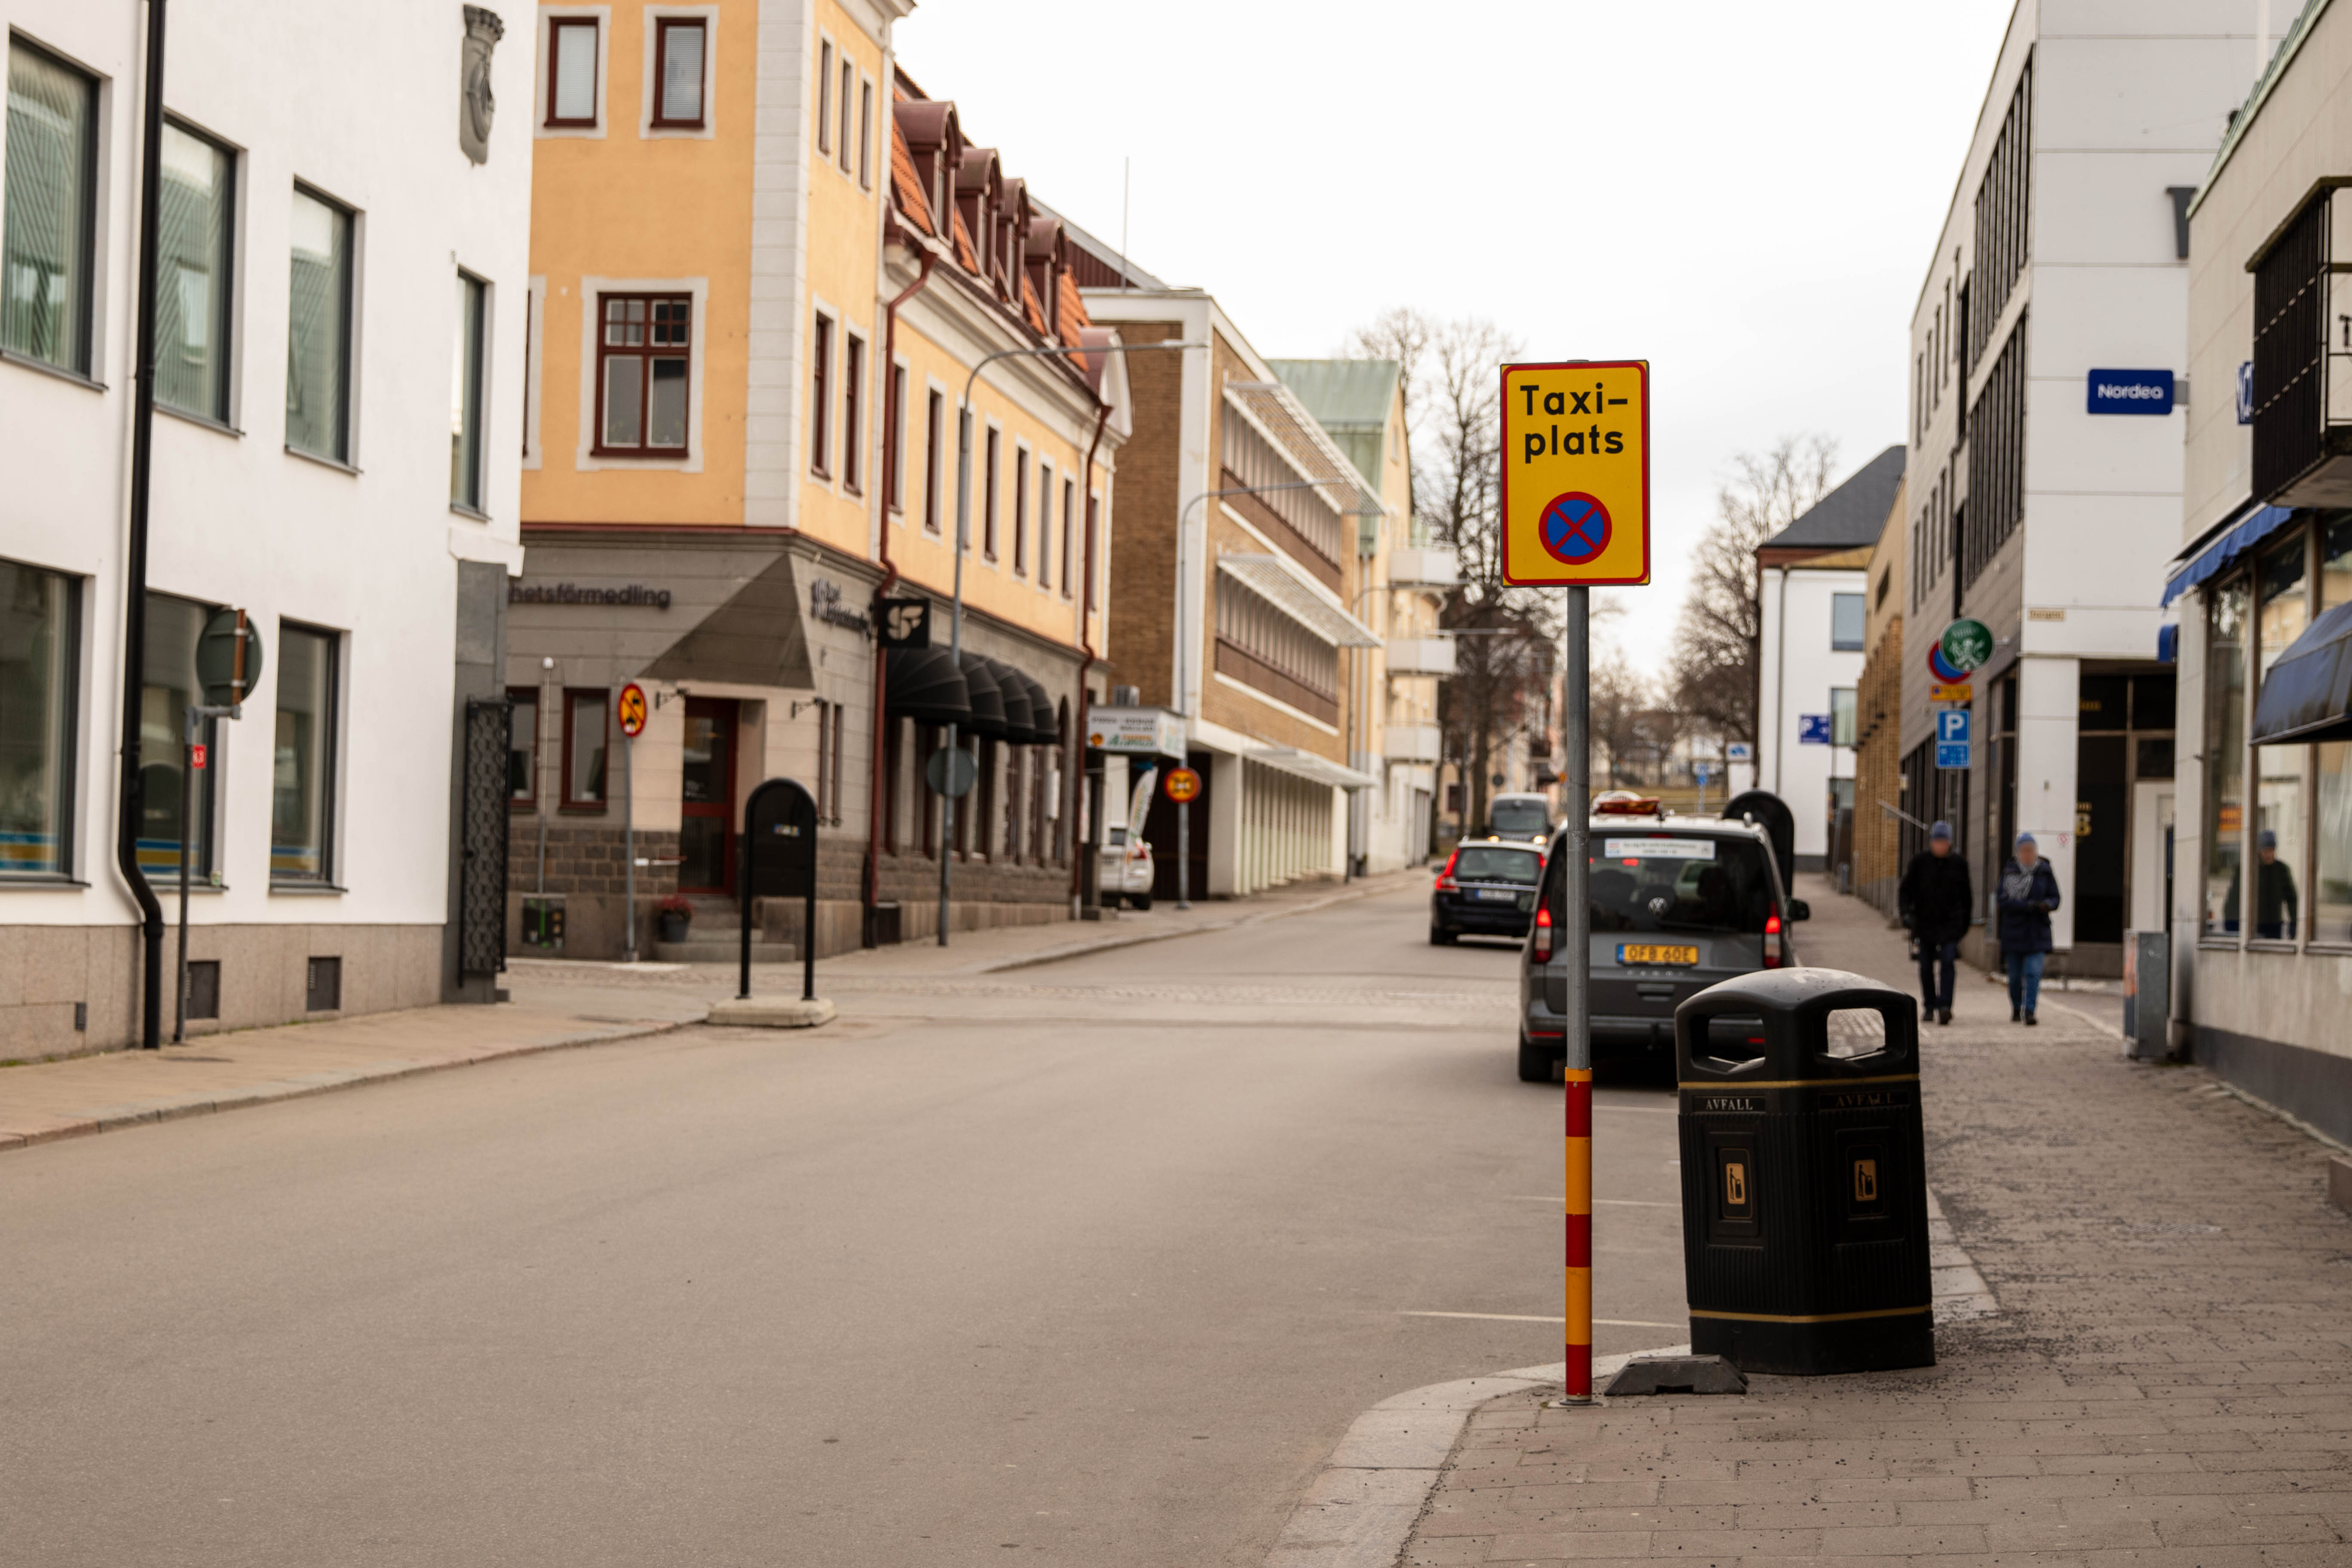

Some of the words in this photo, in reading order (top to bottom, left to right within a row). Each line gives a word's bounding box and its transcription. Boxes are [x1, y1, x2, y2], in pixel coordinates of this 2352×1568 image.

[1520, 382, 1628, 415] Taxi-
[2098, 383, 2164, 400] Nordea
[1525, 424, 1623, 464] plats
[509, 582, 671, 608] hetsförmedling
[1945, 714, 1965, 740] P
[1706, 1098, 1753, 1111] AVFALL
[1836, 1093, 1895, 1107] AVFALL
